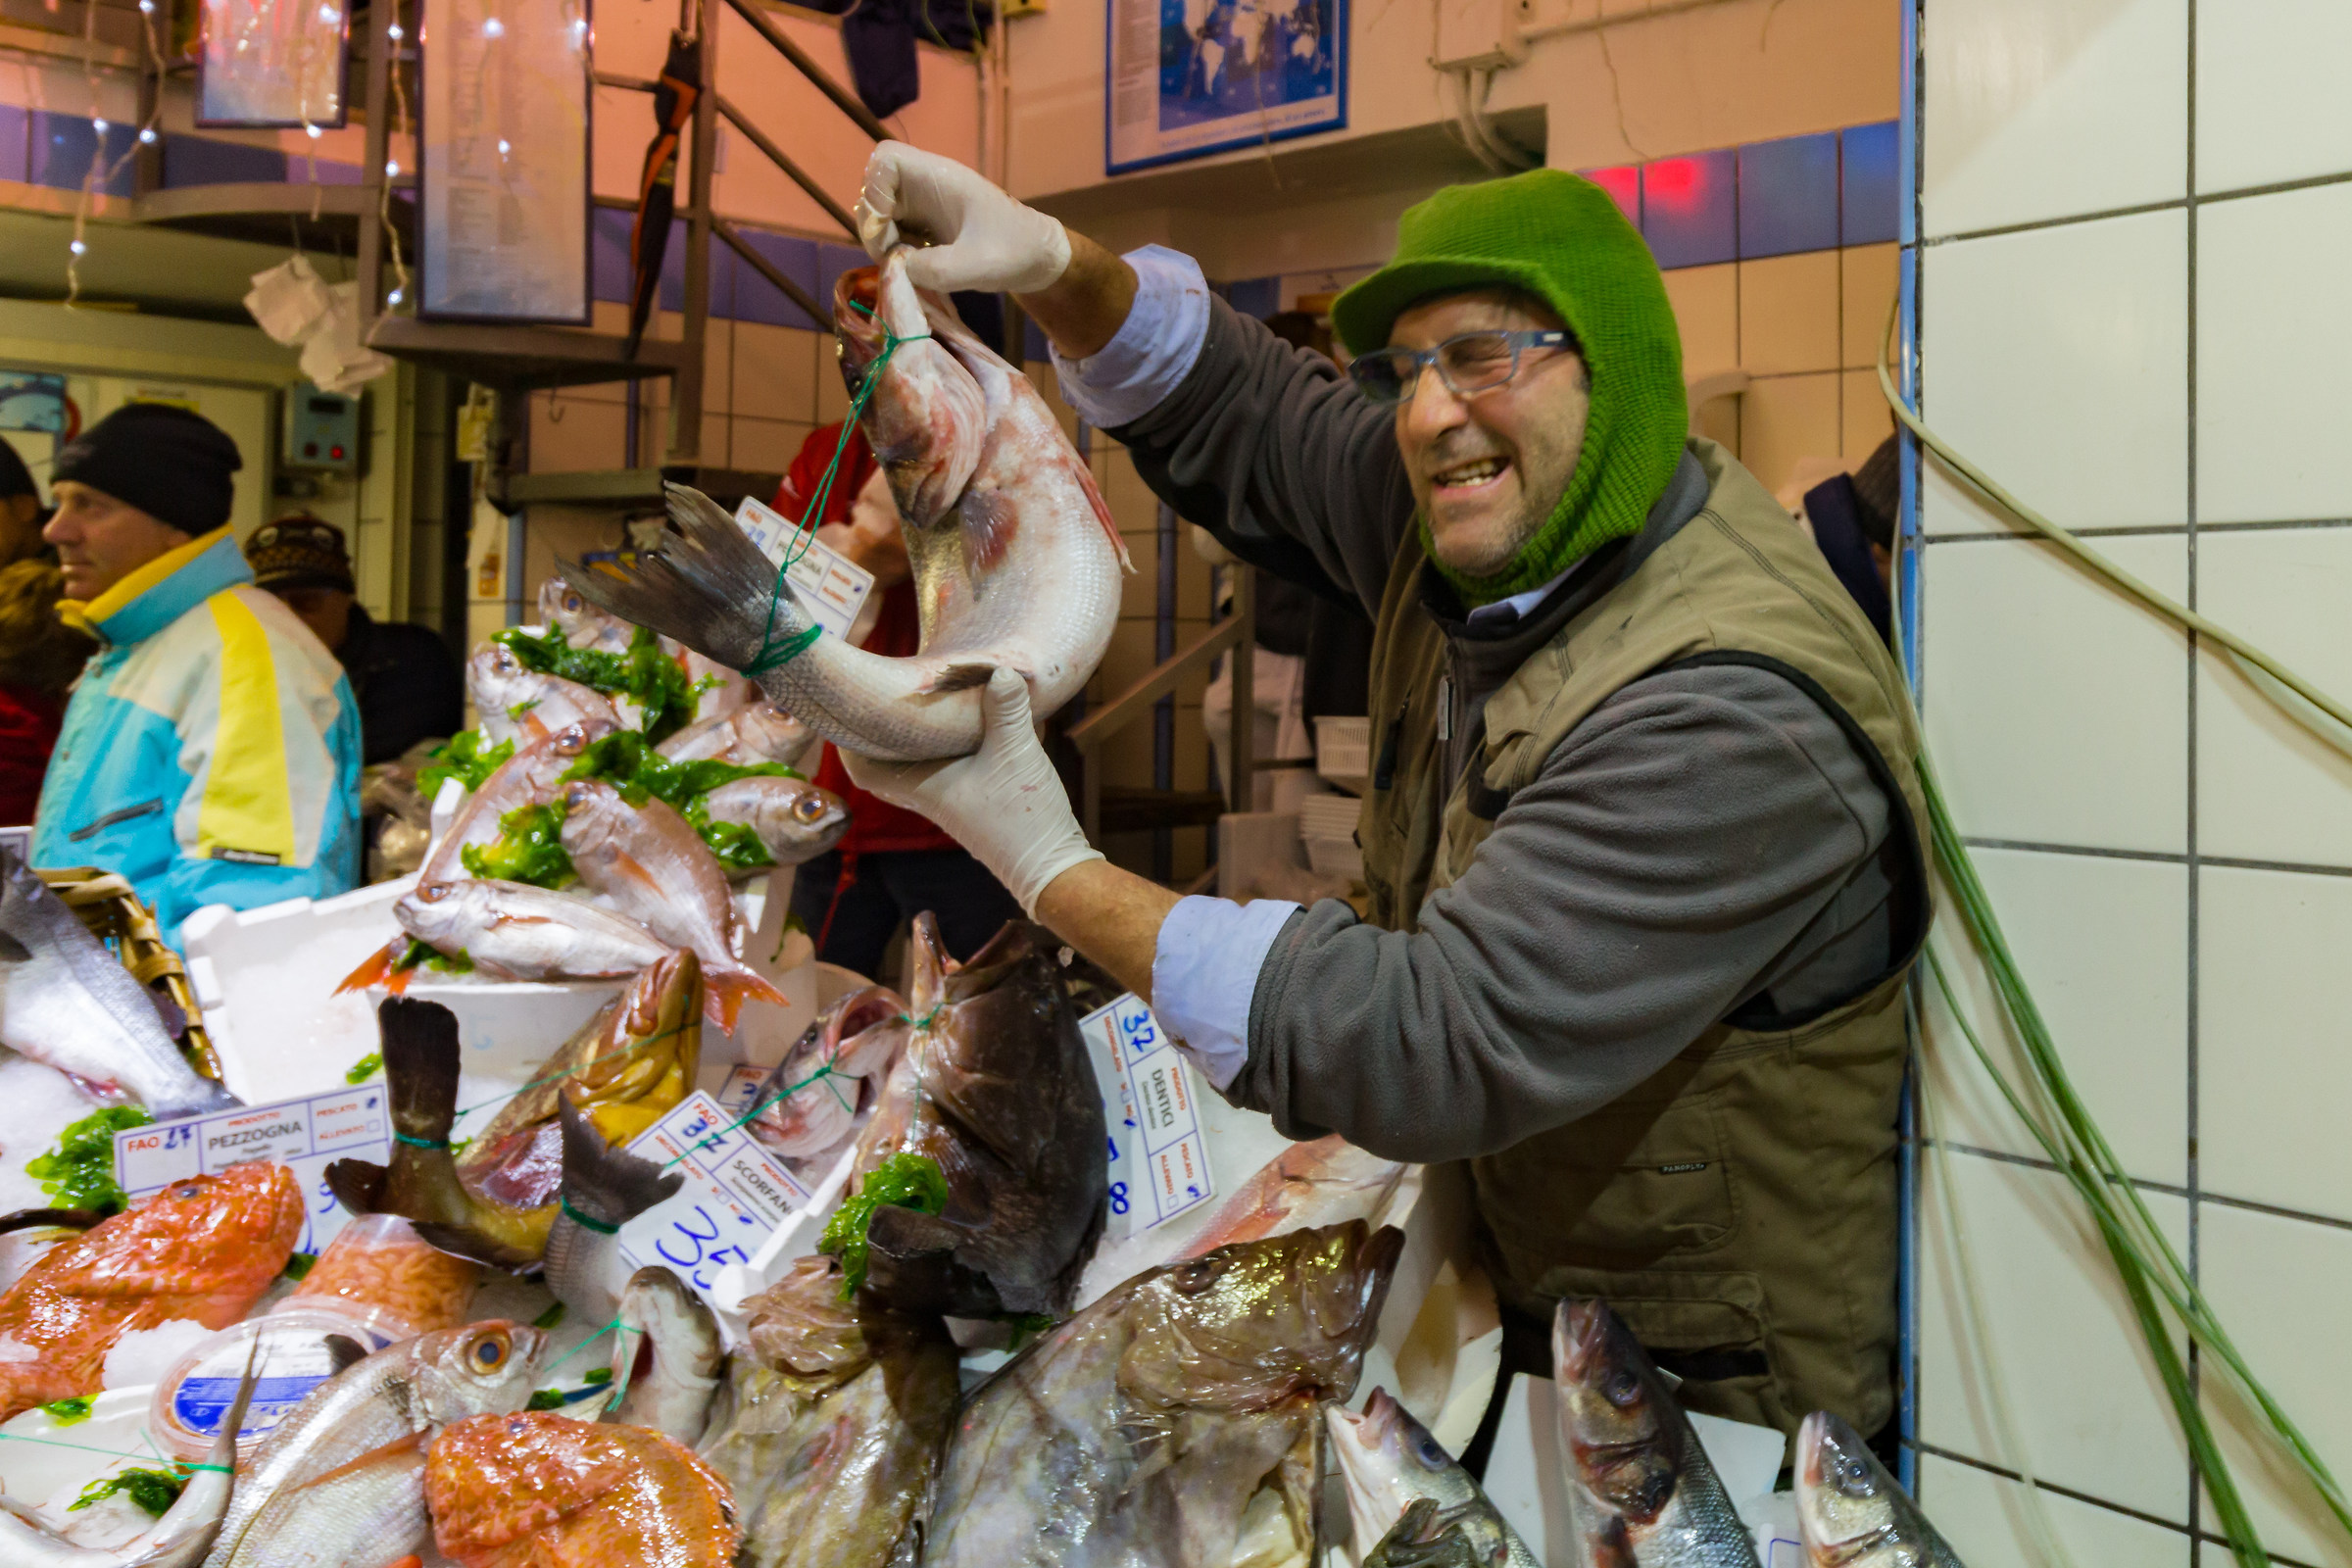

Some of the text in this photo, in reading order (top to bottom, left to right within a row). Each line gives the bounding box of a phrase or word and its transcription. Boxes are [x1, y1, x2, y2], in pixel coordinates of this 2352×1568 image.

[1122, 1009, 1156, 1053] 37
[1152, 1068, 1175, 1128] DENTICI
[1170, 1066, 1188, 1111] PRODOTTO
[227, 1111, 281, 1128] PRODOTTO
[316, 1102, 359, 1118] PESCATO
[693, 1102, 719, 1126] FAO
[127, 1136, 160, 1152] FAO
[208, 1121, 305, 1151] PEZZOGNA
[733, 1159, 792, 1215] SCORFAN
